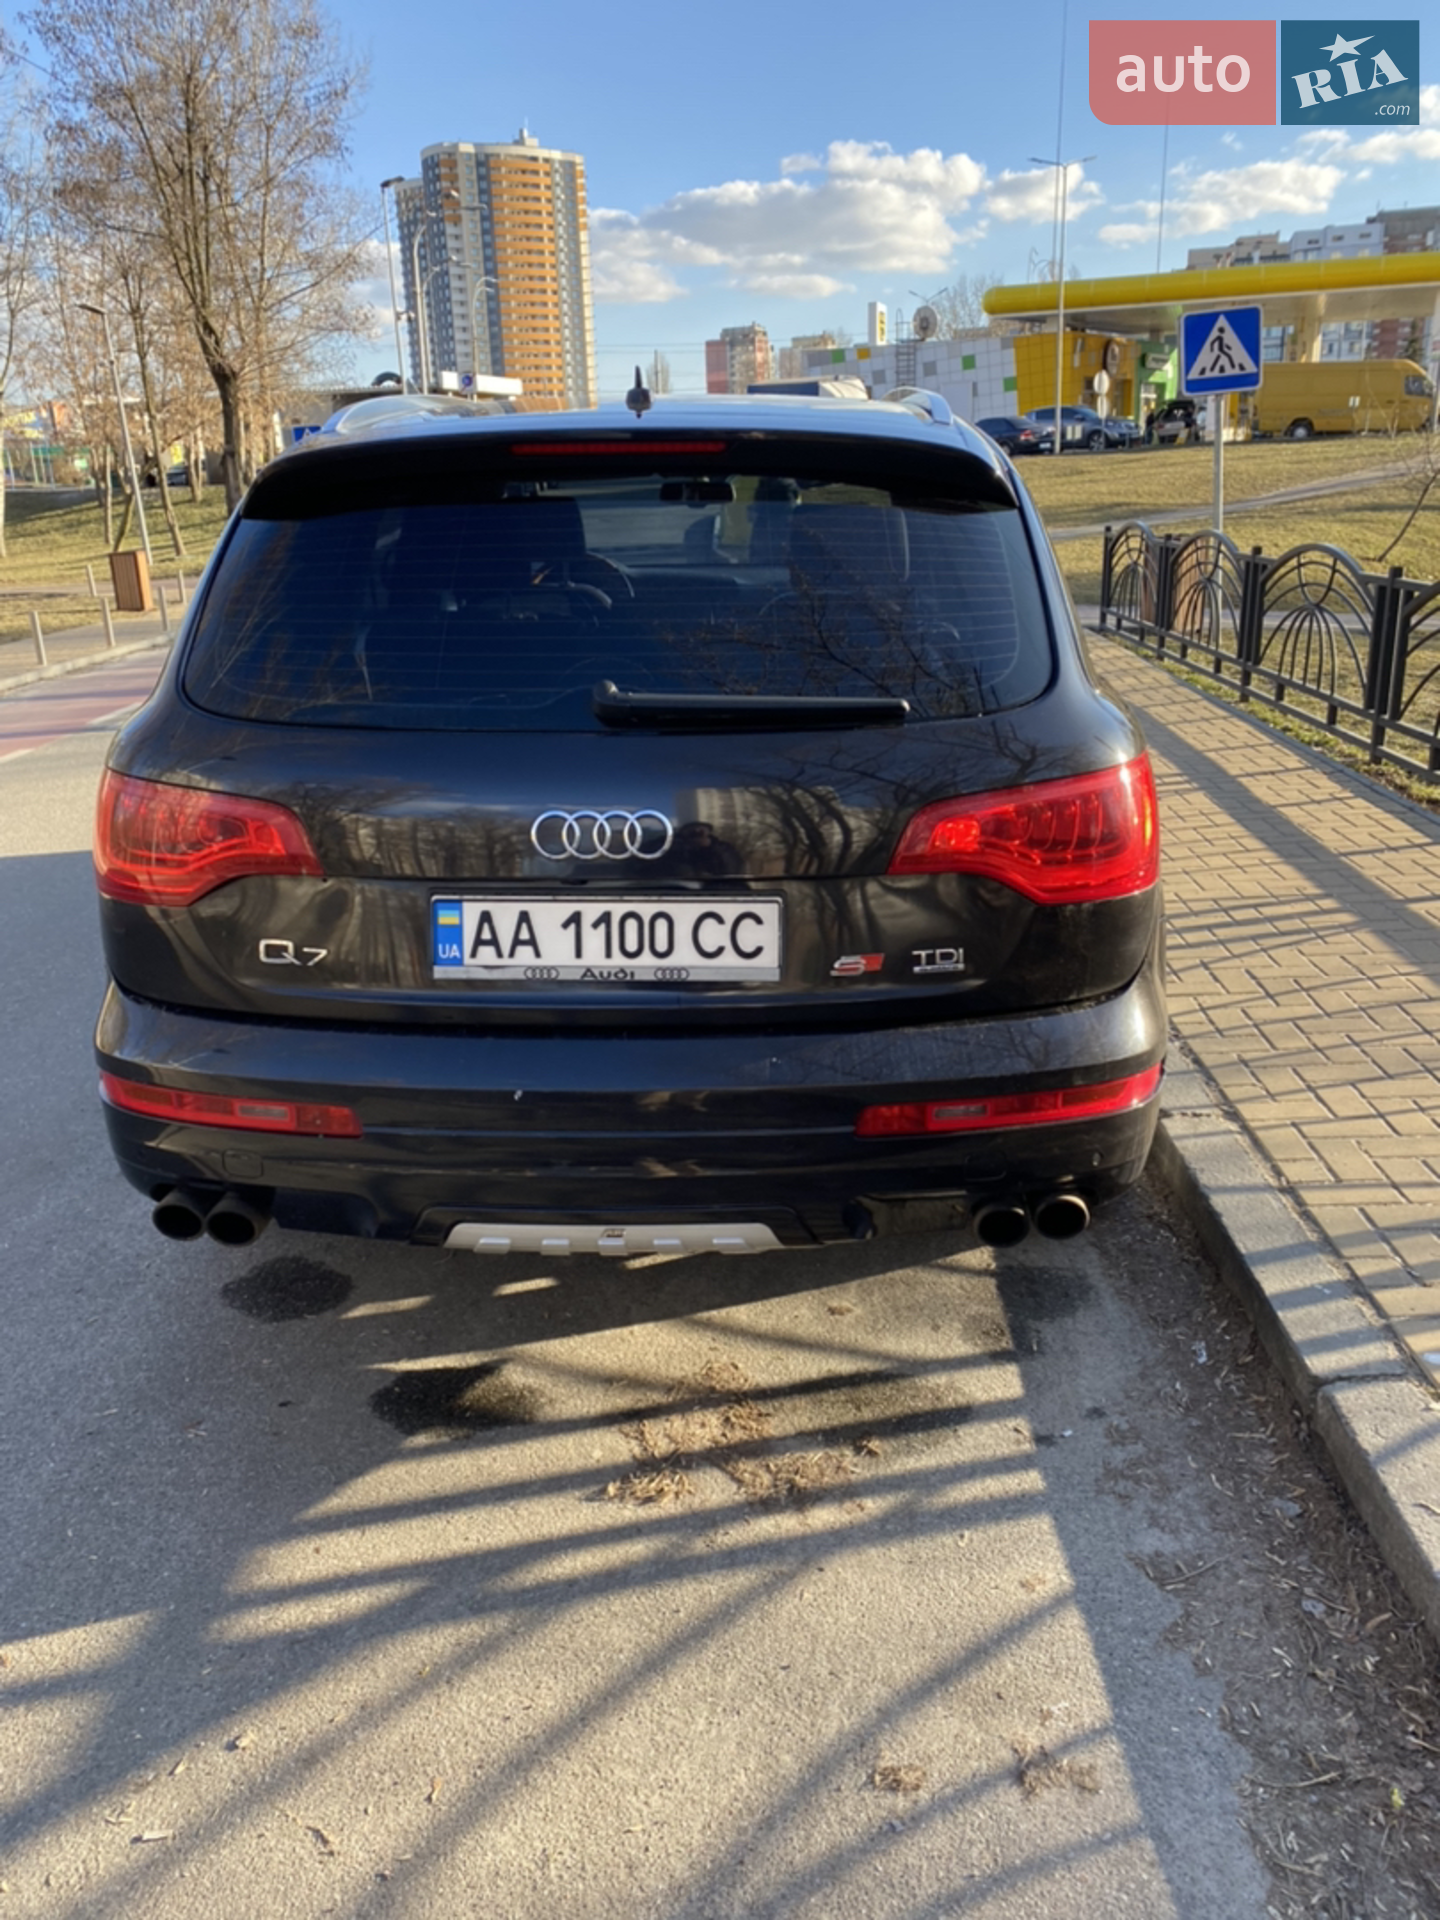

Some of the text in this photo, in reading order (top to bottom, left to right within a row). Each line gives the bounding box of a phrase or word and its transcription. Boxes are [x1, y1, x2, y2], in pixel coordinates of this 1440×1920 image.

[469, 910, 764, 959] AA 1100 CC
[259, 939, 328, 966] Q7
[438, 943, 460, 959] UA
[912, 948, 964, 966] TDI
[580, 967, 635, 981] Audi
